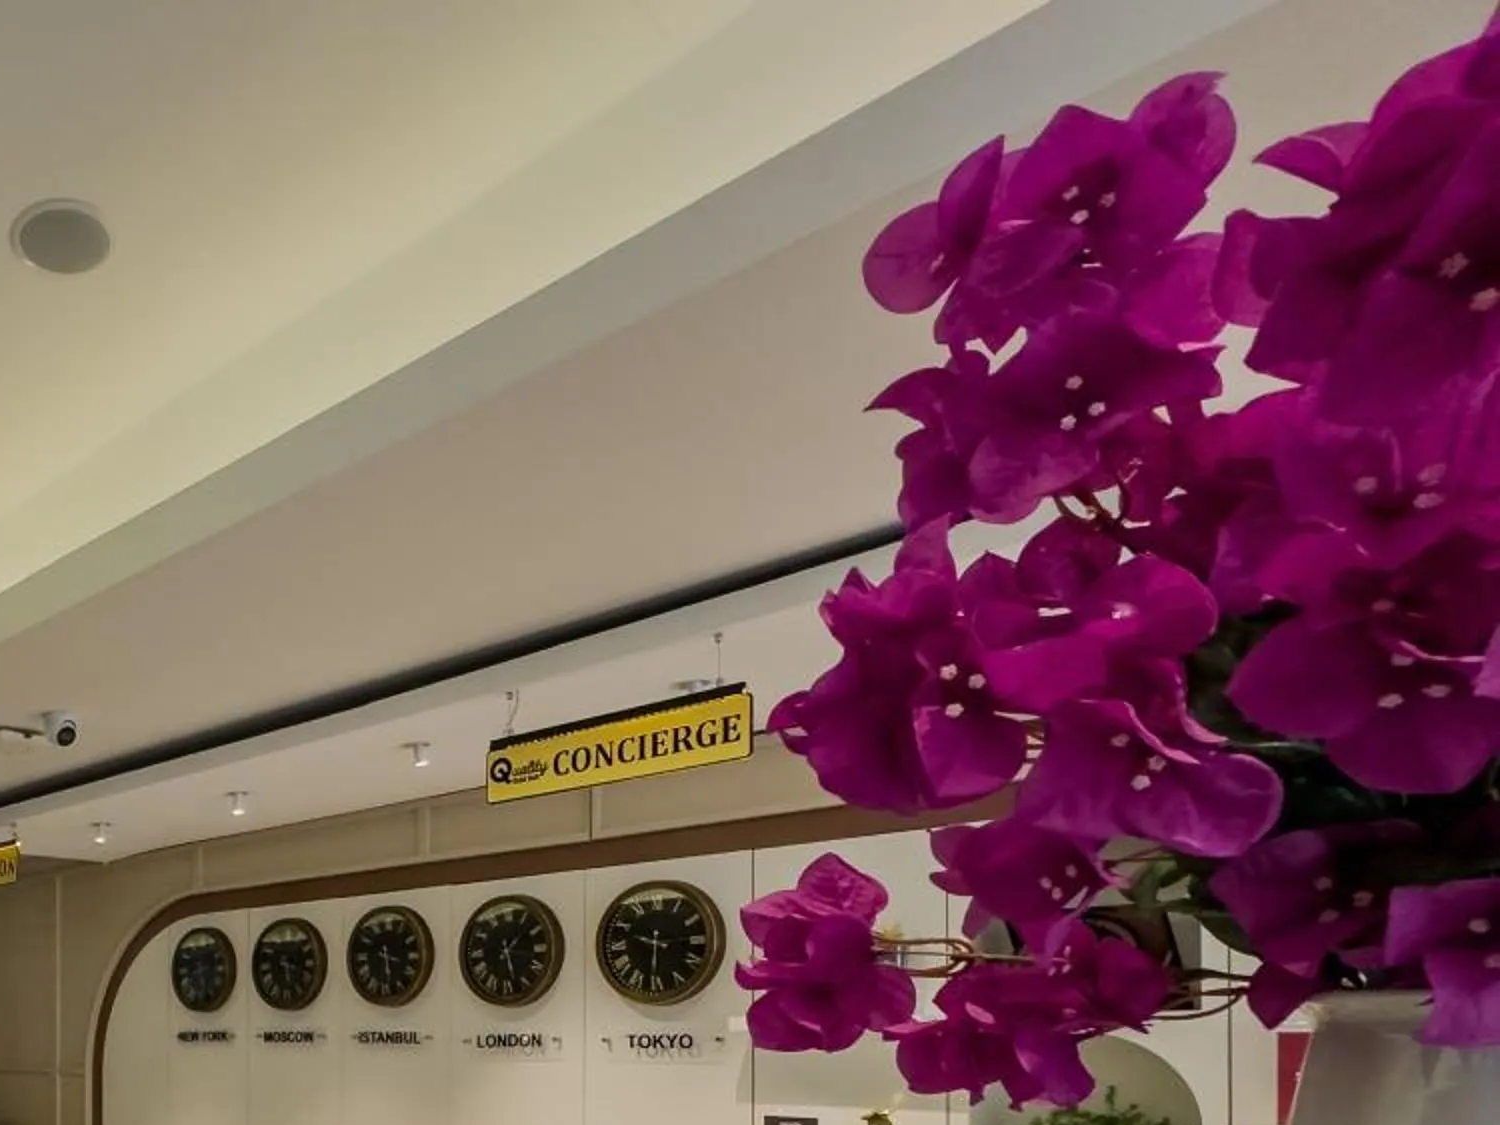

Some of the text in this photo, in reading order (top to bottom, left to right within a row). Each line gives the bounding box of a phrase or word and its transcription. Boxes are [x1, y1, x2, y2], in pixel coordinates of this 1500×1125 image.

[553, 713, 741, 776] CONCIERGE
[263, 1031, 314, 1043] MOSCOW
[476, 1033, 543, 1049] LONDON
[627, 1033, 694, 1050] TOKYO
